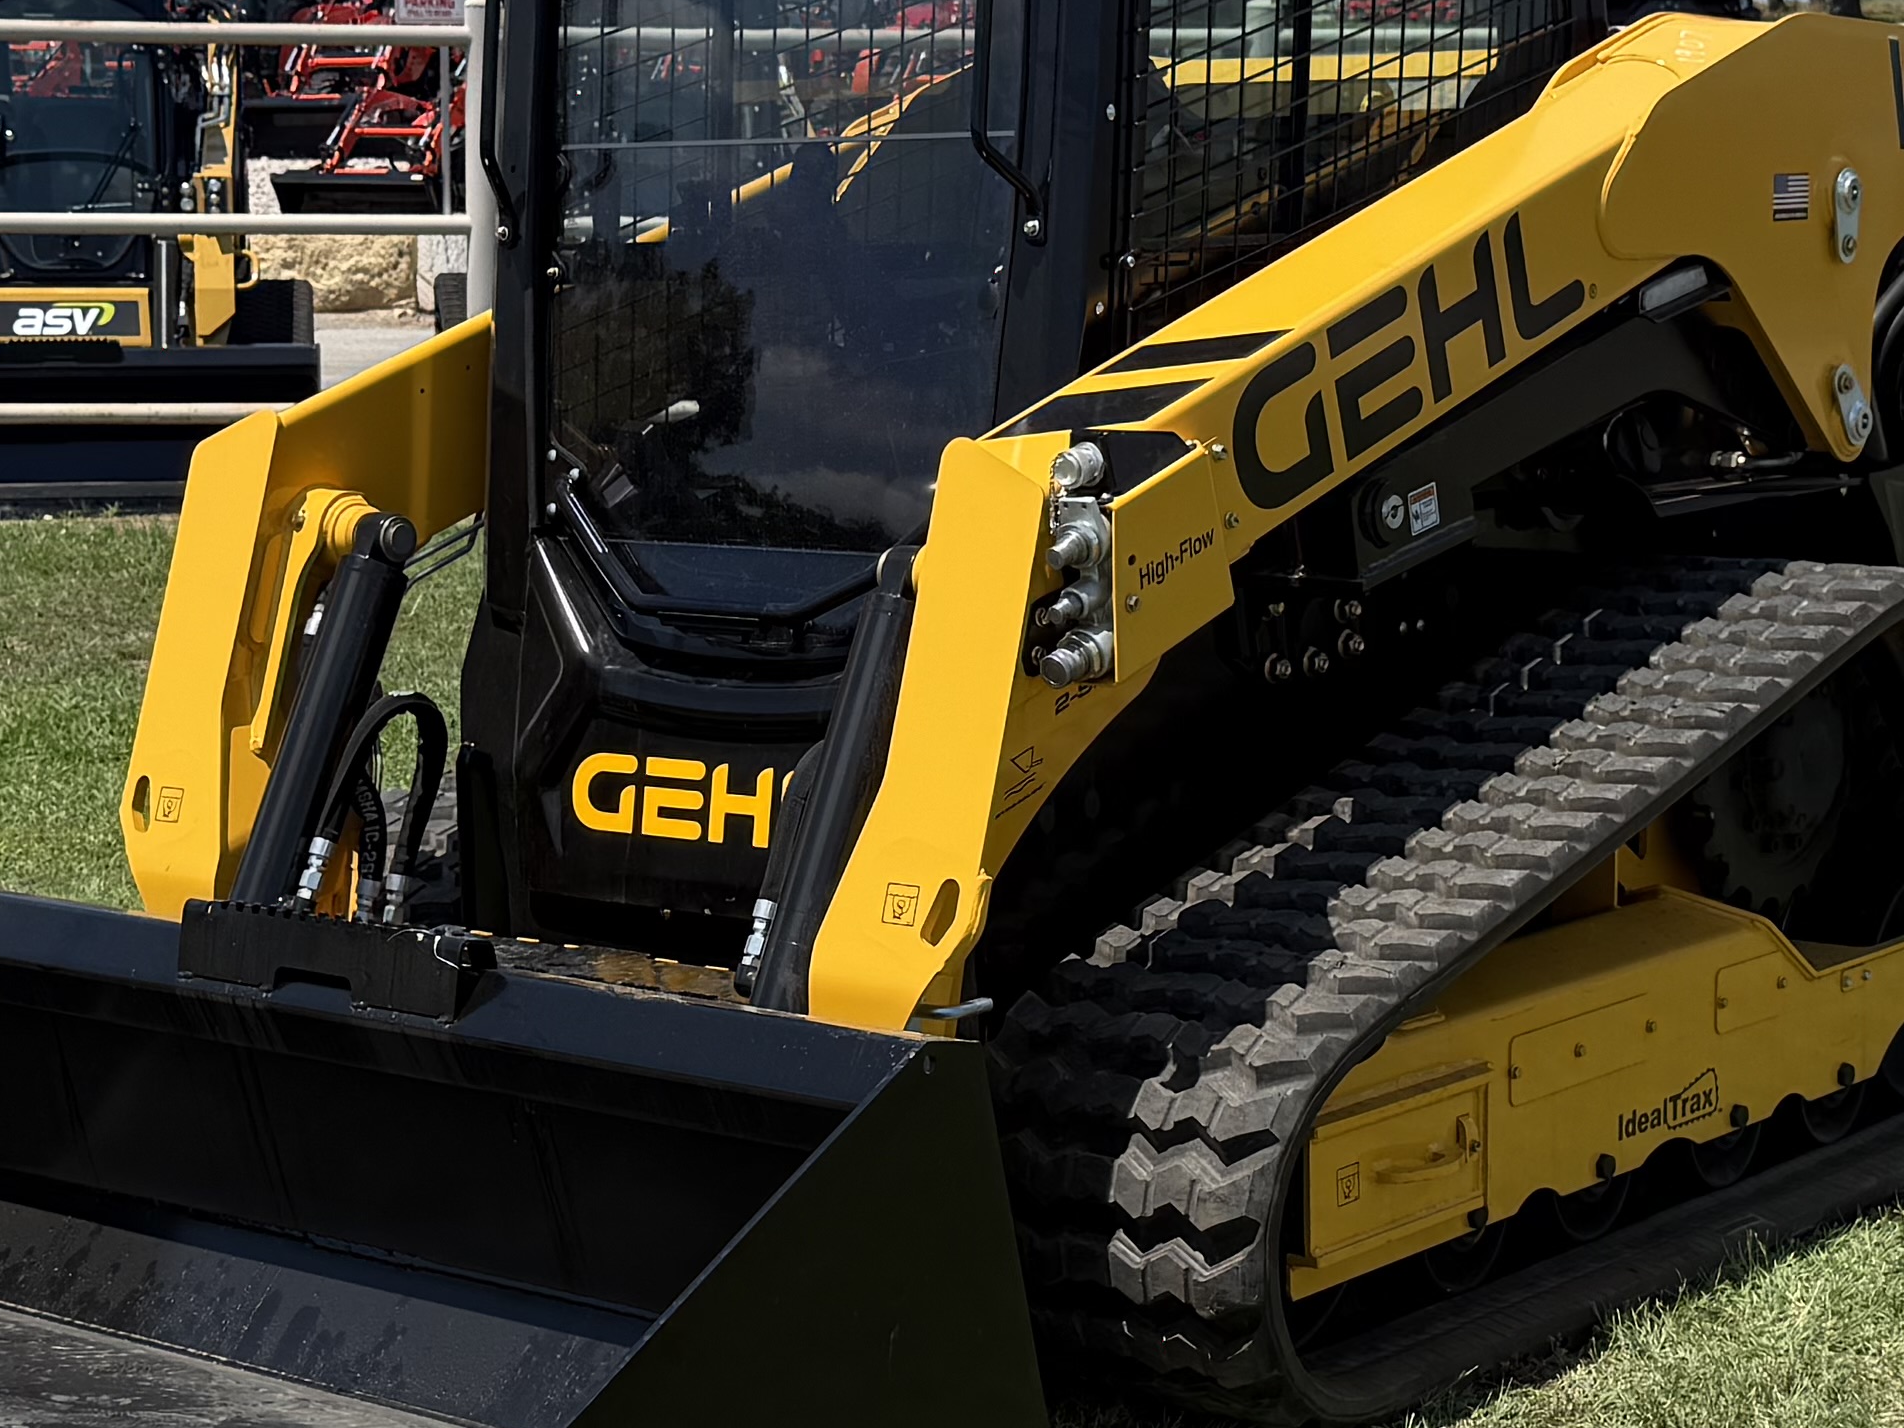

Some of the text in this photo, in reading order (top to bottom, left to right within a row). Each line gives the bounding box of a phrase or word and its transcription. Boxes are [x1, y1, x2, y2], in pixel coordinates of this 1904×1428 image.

[1233, 211, 1585, 509] GEHL
[1139, 528, 1214, 590] High-Flow
[572, 752, 795, 848] GEH
[1618, 1087, 1714, 1141] IdealTrax
